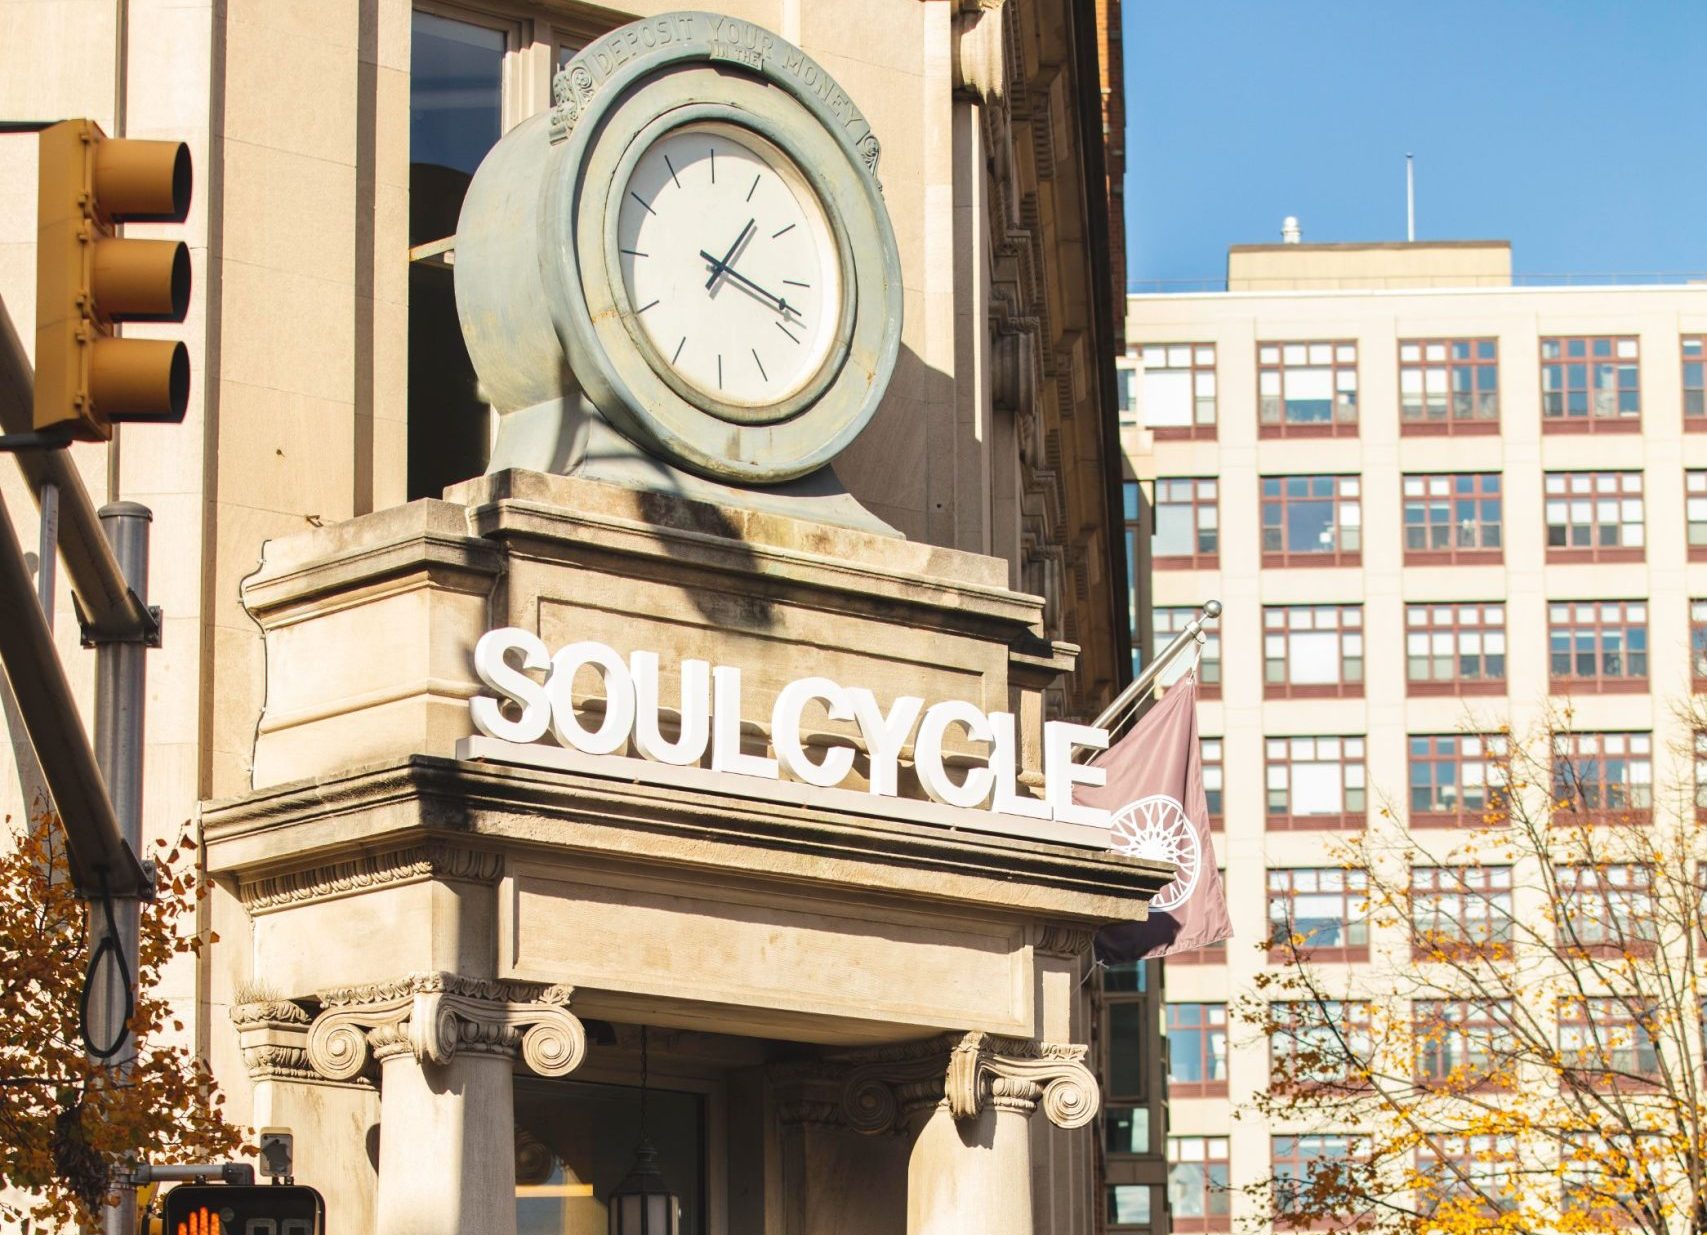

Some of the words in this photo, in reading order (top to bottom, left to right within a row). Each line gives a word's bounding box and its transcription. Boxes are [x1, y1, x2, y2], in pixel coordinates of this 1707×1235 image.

[597, 17, 694, 77] DEPOSIT
[705, 17, 774, 61] YOUR
[782, 48, 863, 128] MONEY
[714, 45, 730, 59] IN
[735, 49, 762, 67] THE
[469, 627, 1110, 827] SOULCYCLE
